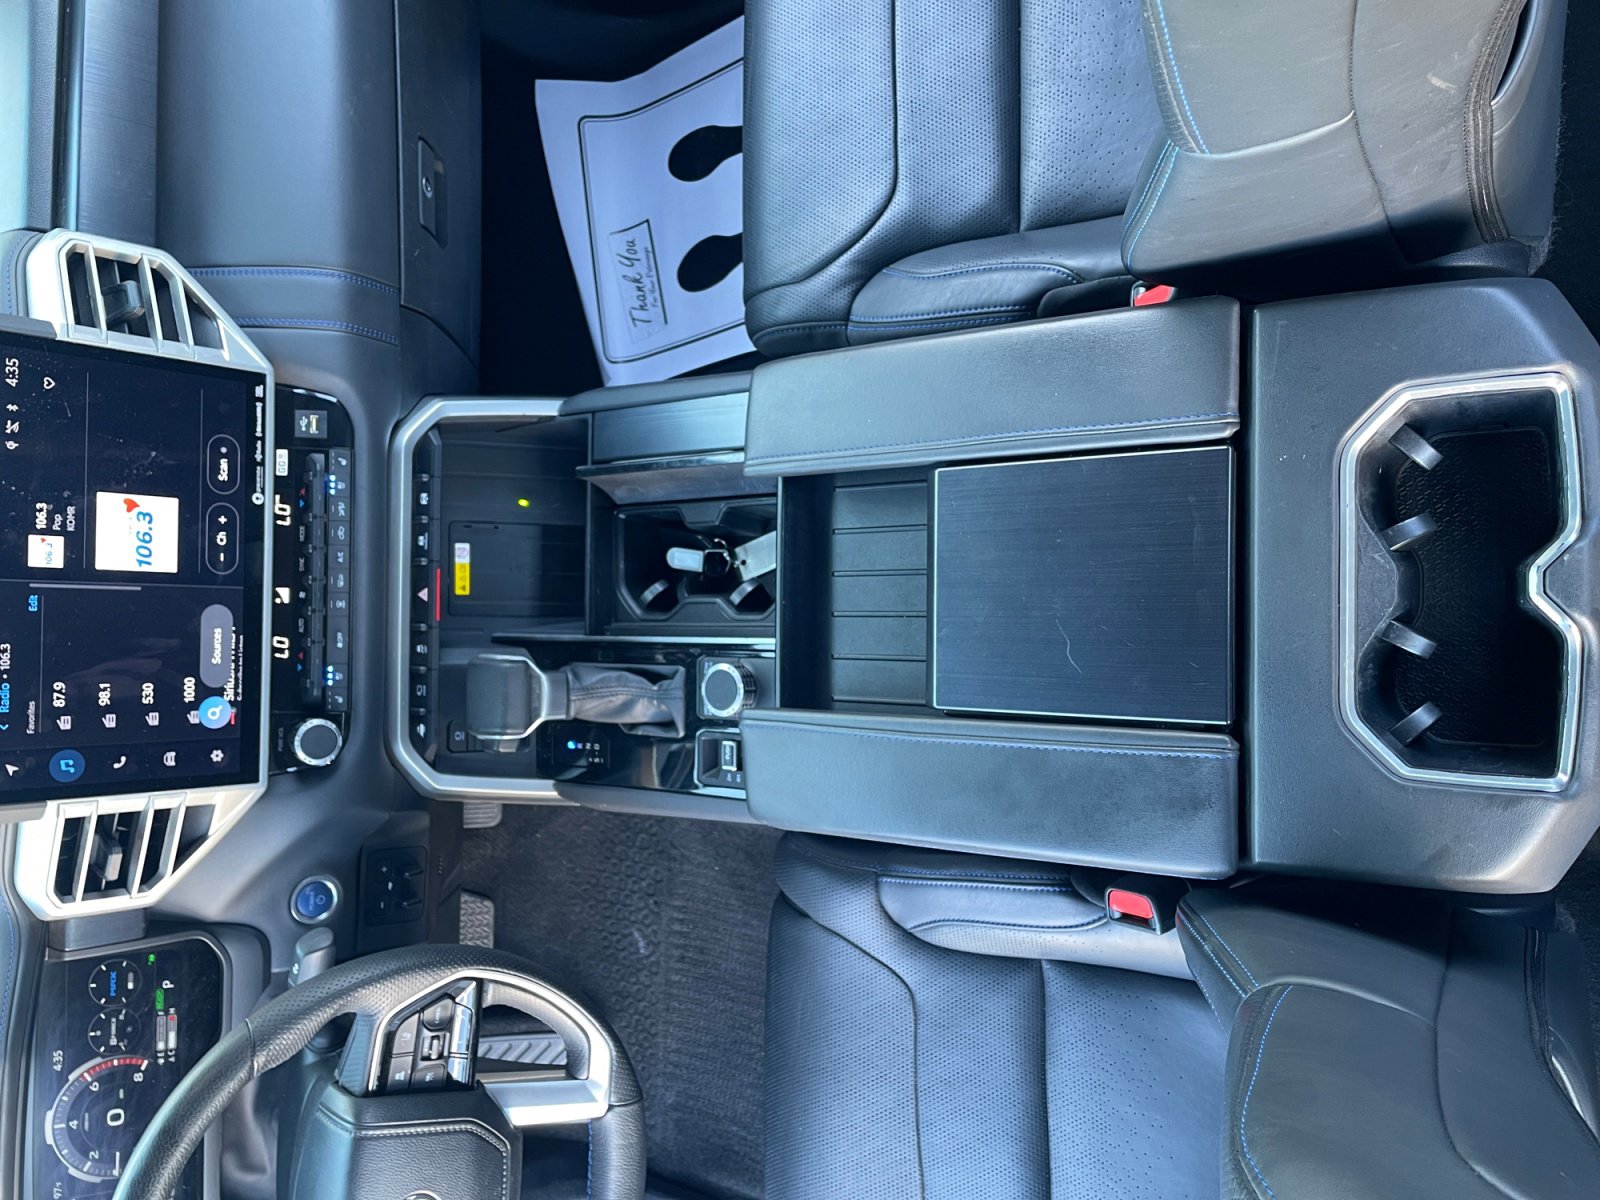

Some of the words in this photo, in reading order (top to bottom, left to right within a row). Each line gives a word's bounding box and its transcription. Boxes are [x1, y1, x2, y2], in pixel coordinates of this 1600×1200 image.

[615, 238, 641, 267] You
[622, 272, 652, 328] Thank
[5, 358, 19, 387] 4:35
[218, 458, 229, 482] Scan
[35, 502, 47, 530] 106.3
[52, 514, 63, 531] Pop
[66, 506, 76, 532] KOMR
[136, 510, 153, 568] 106.3
[216, 531, 228, 546] Ch
[28, 594, 38, 612] Edit
[0, 644, 10, 670] 106.3
[211, 627, 222, 664] Sources
[272, 636, 289, 659] LO
[0, 682, 10, 713] Radio
[52, 681, 66, 708] 87.9
[98, 682, 112, 706] 98.1
[142, 682, 154, 704] 530
[184, 676, 196, 703] 1000
[26, 700, 36, 734] Favorites
[162, 980, 175, 988] P
[53, 1050, 63, 1072] 4:35
[89, 1081, 100, 1092] 6
[134, 1072, 144, 1082] 8
[68, 1120, 78, 1130] 4
[106, 1108, 125, 1126] 0
[89, 1150, 99, 1160] 2
